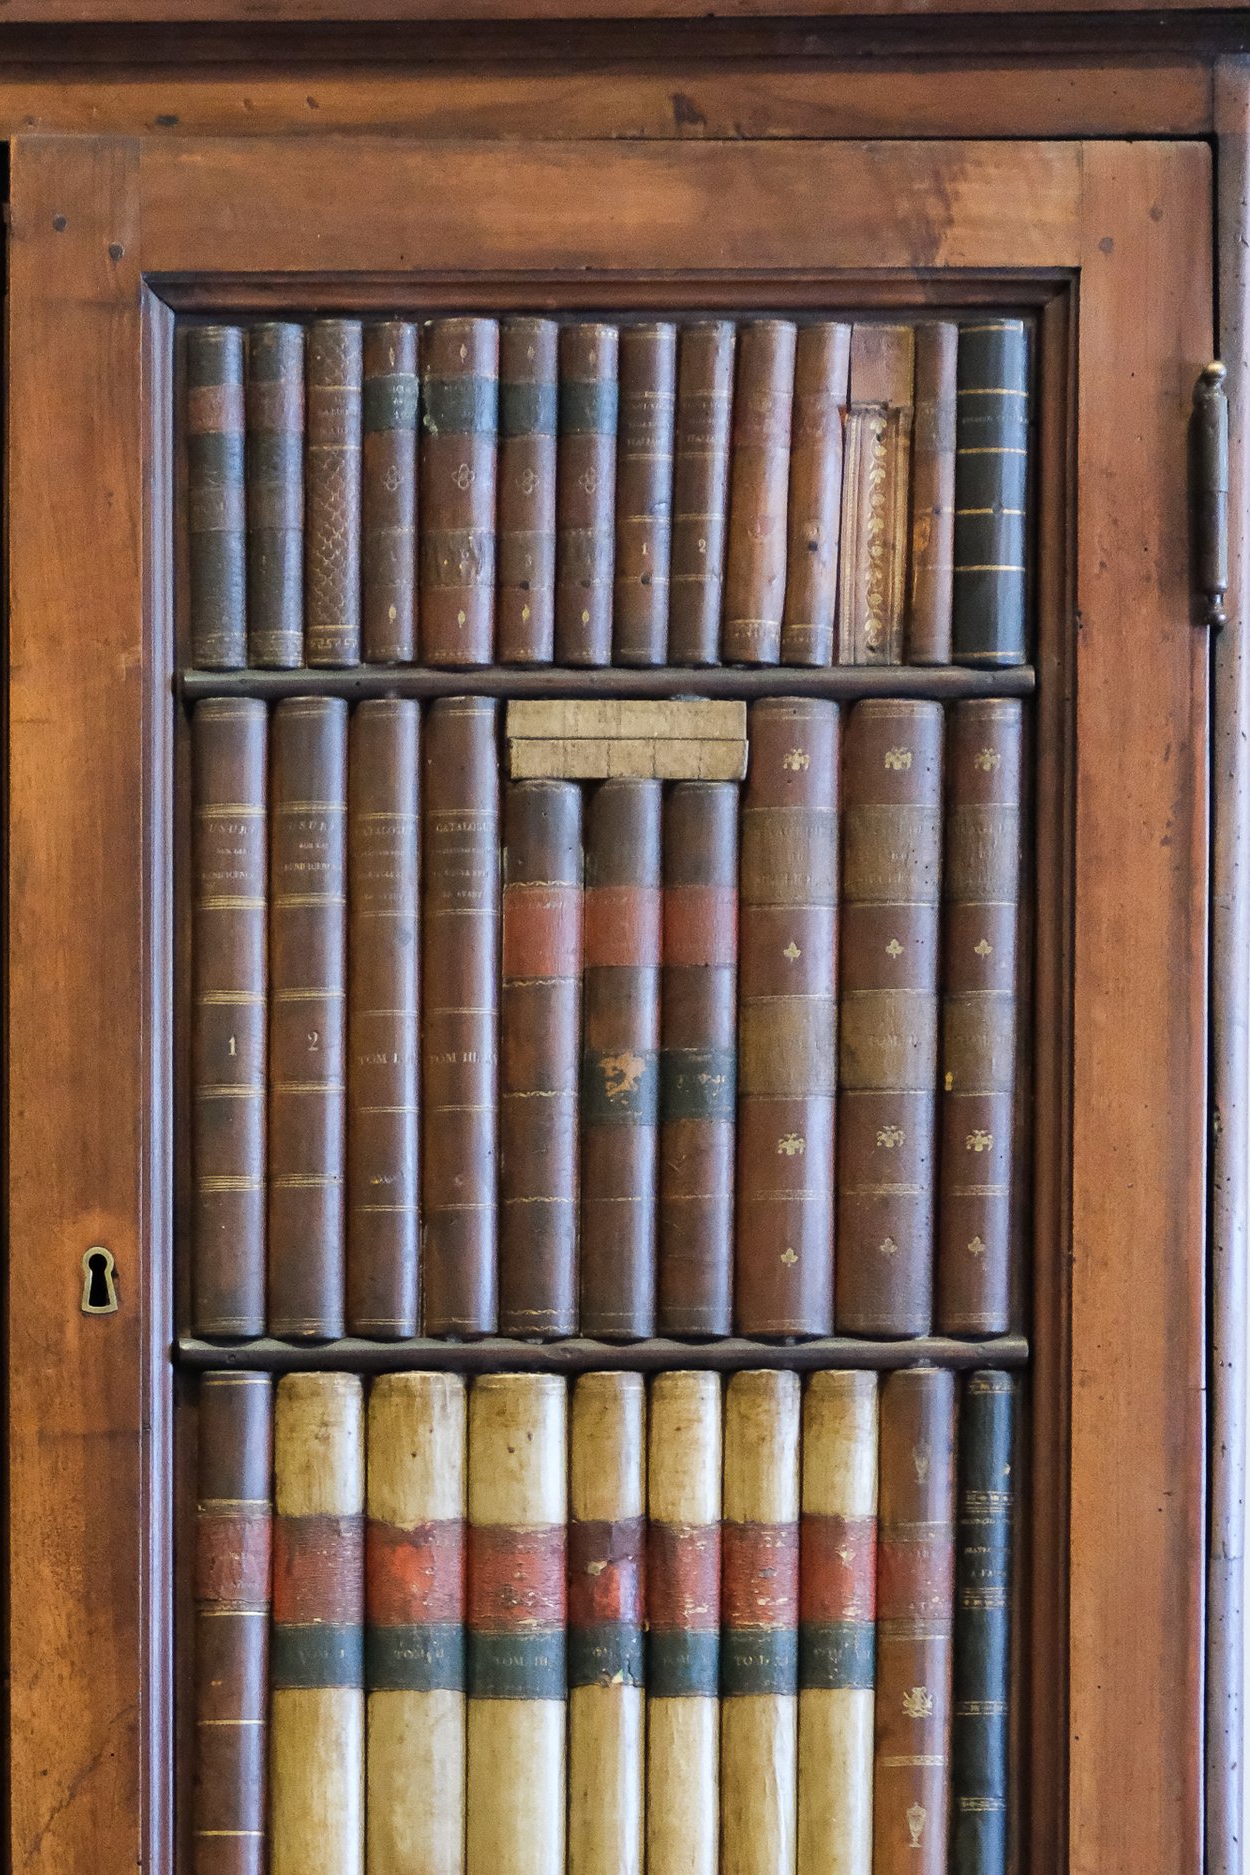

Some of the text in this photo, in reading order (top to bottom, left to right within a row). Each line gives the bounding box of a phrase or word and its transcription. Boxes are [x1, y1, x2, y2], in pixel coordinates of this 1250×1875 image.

[697, 537, 709, 554] 2
[228, 1036, 239, 1057] 1
[307, 1031, 320, 1052] 2
